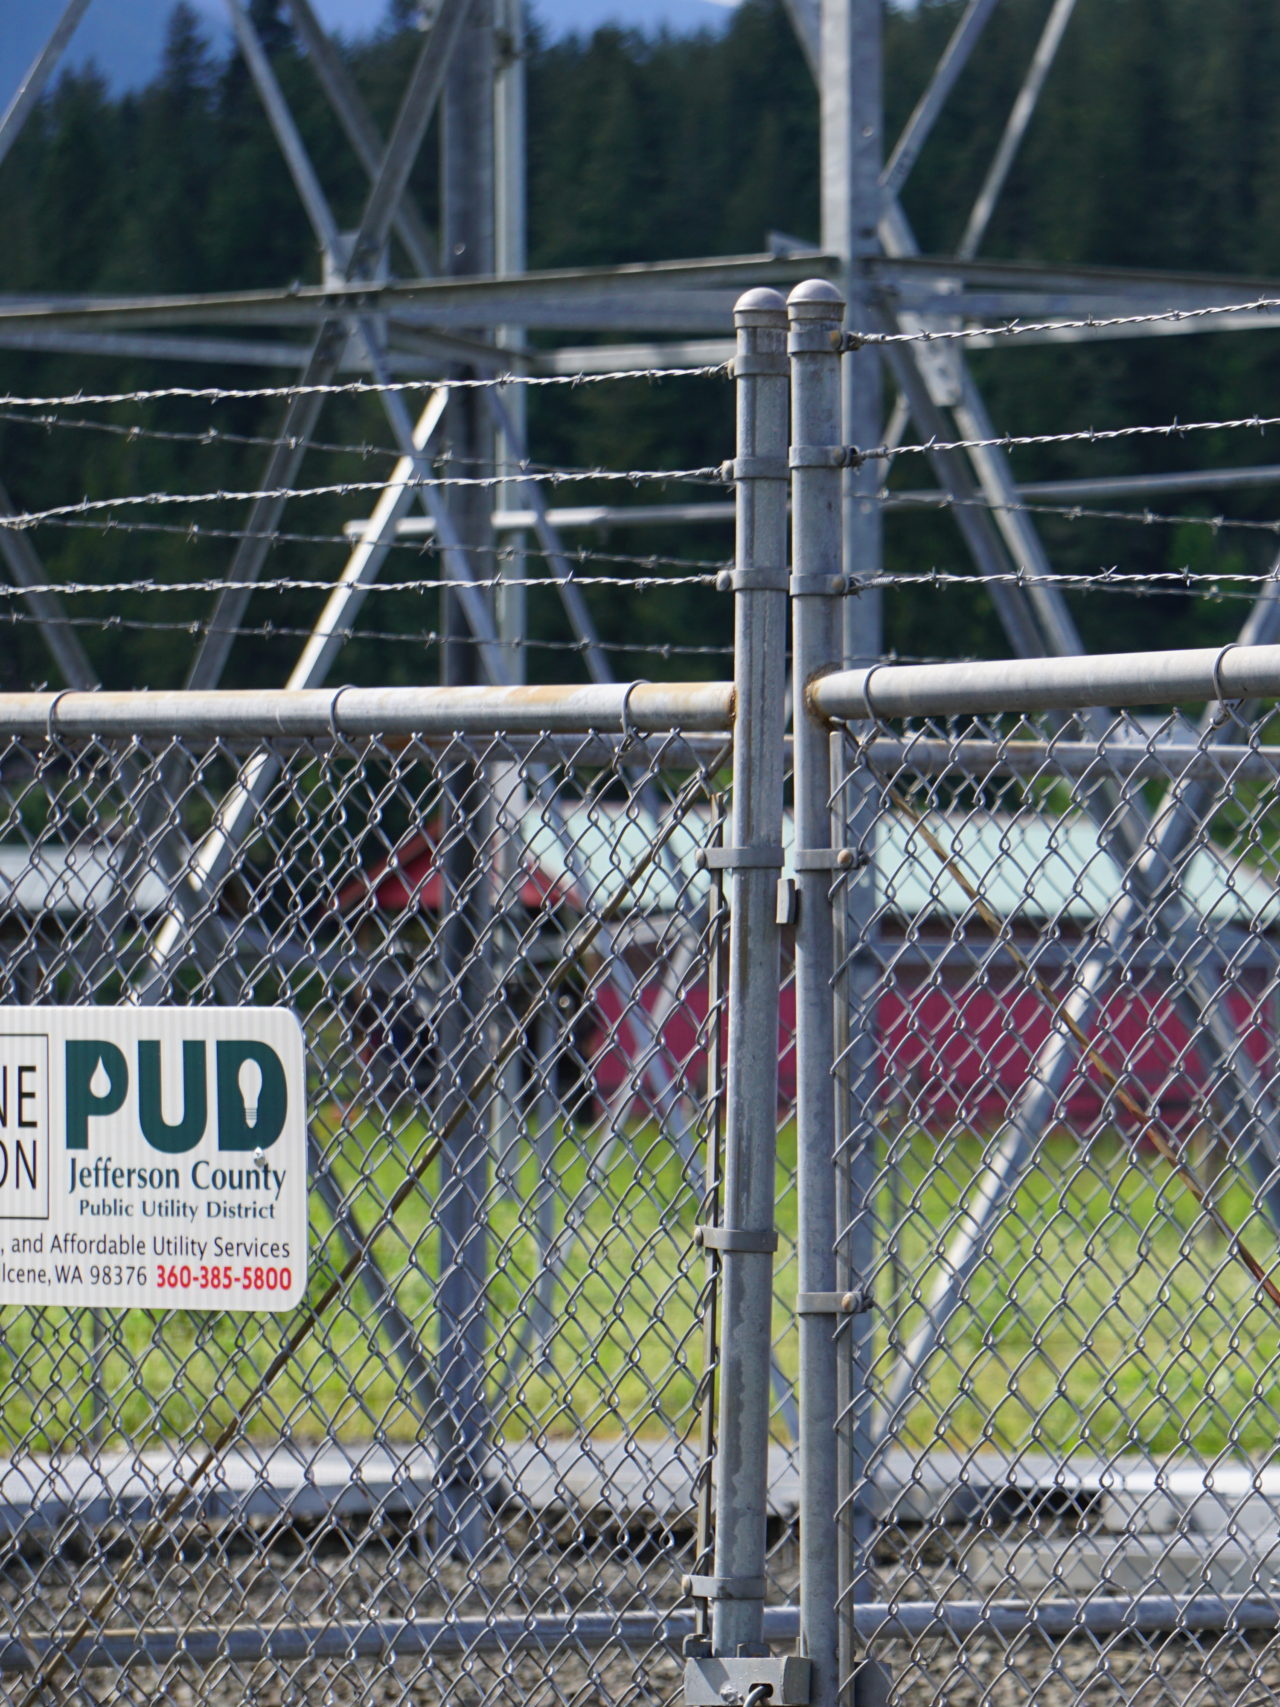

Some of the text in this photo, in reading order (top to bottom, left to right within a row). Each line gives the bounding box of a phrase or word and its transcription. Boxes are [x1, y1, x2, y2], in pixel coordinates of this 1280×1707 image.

[65, 1039, 288, 1154] PUD
[69, 1157, 287, 1200] Jefferson County
[79, 1199, 276, 1222] Public Utility District
[11, 1233, 290, 1261] and Affordable Utility Services
[55, 1265, 83, 1284] WA
[90, 1265, 147, 1286] 98376
[156, 1264, 293, 1290] 360-385-5800
